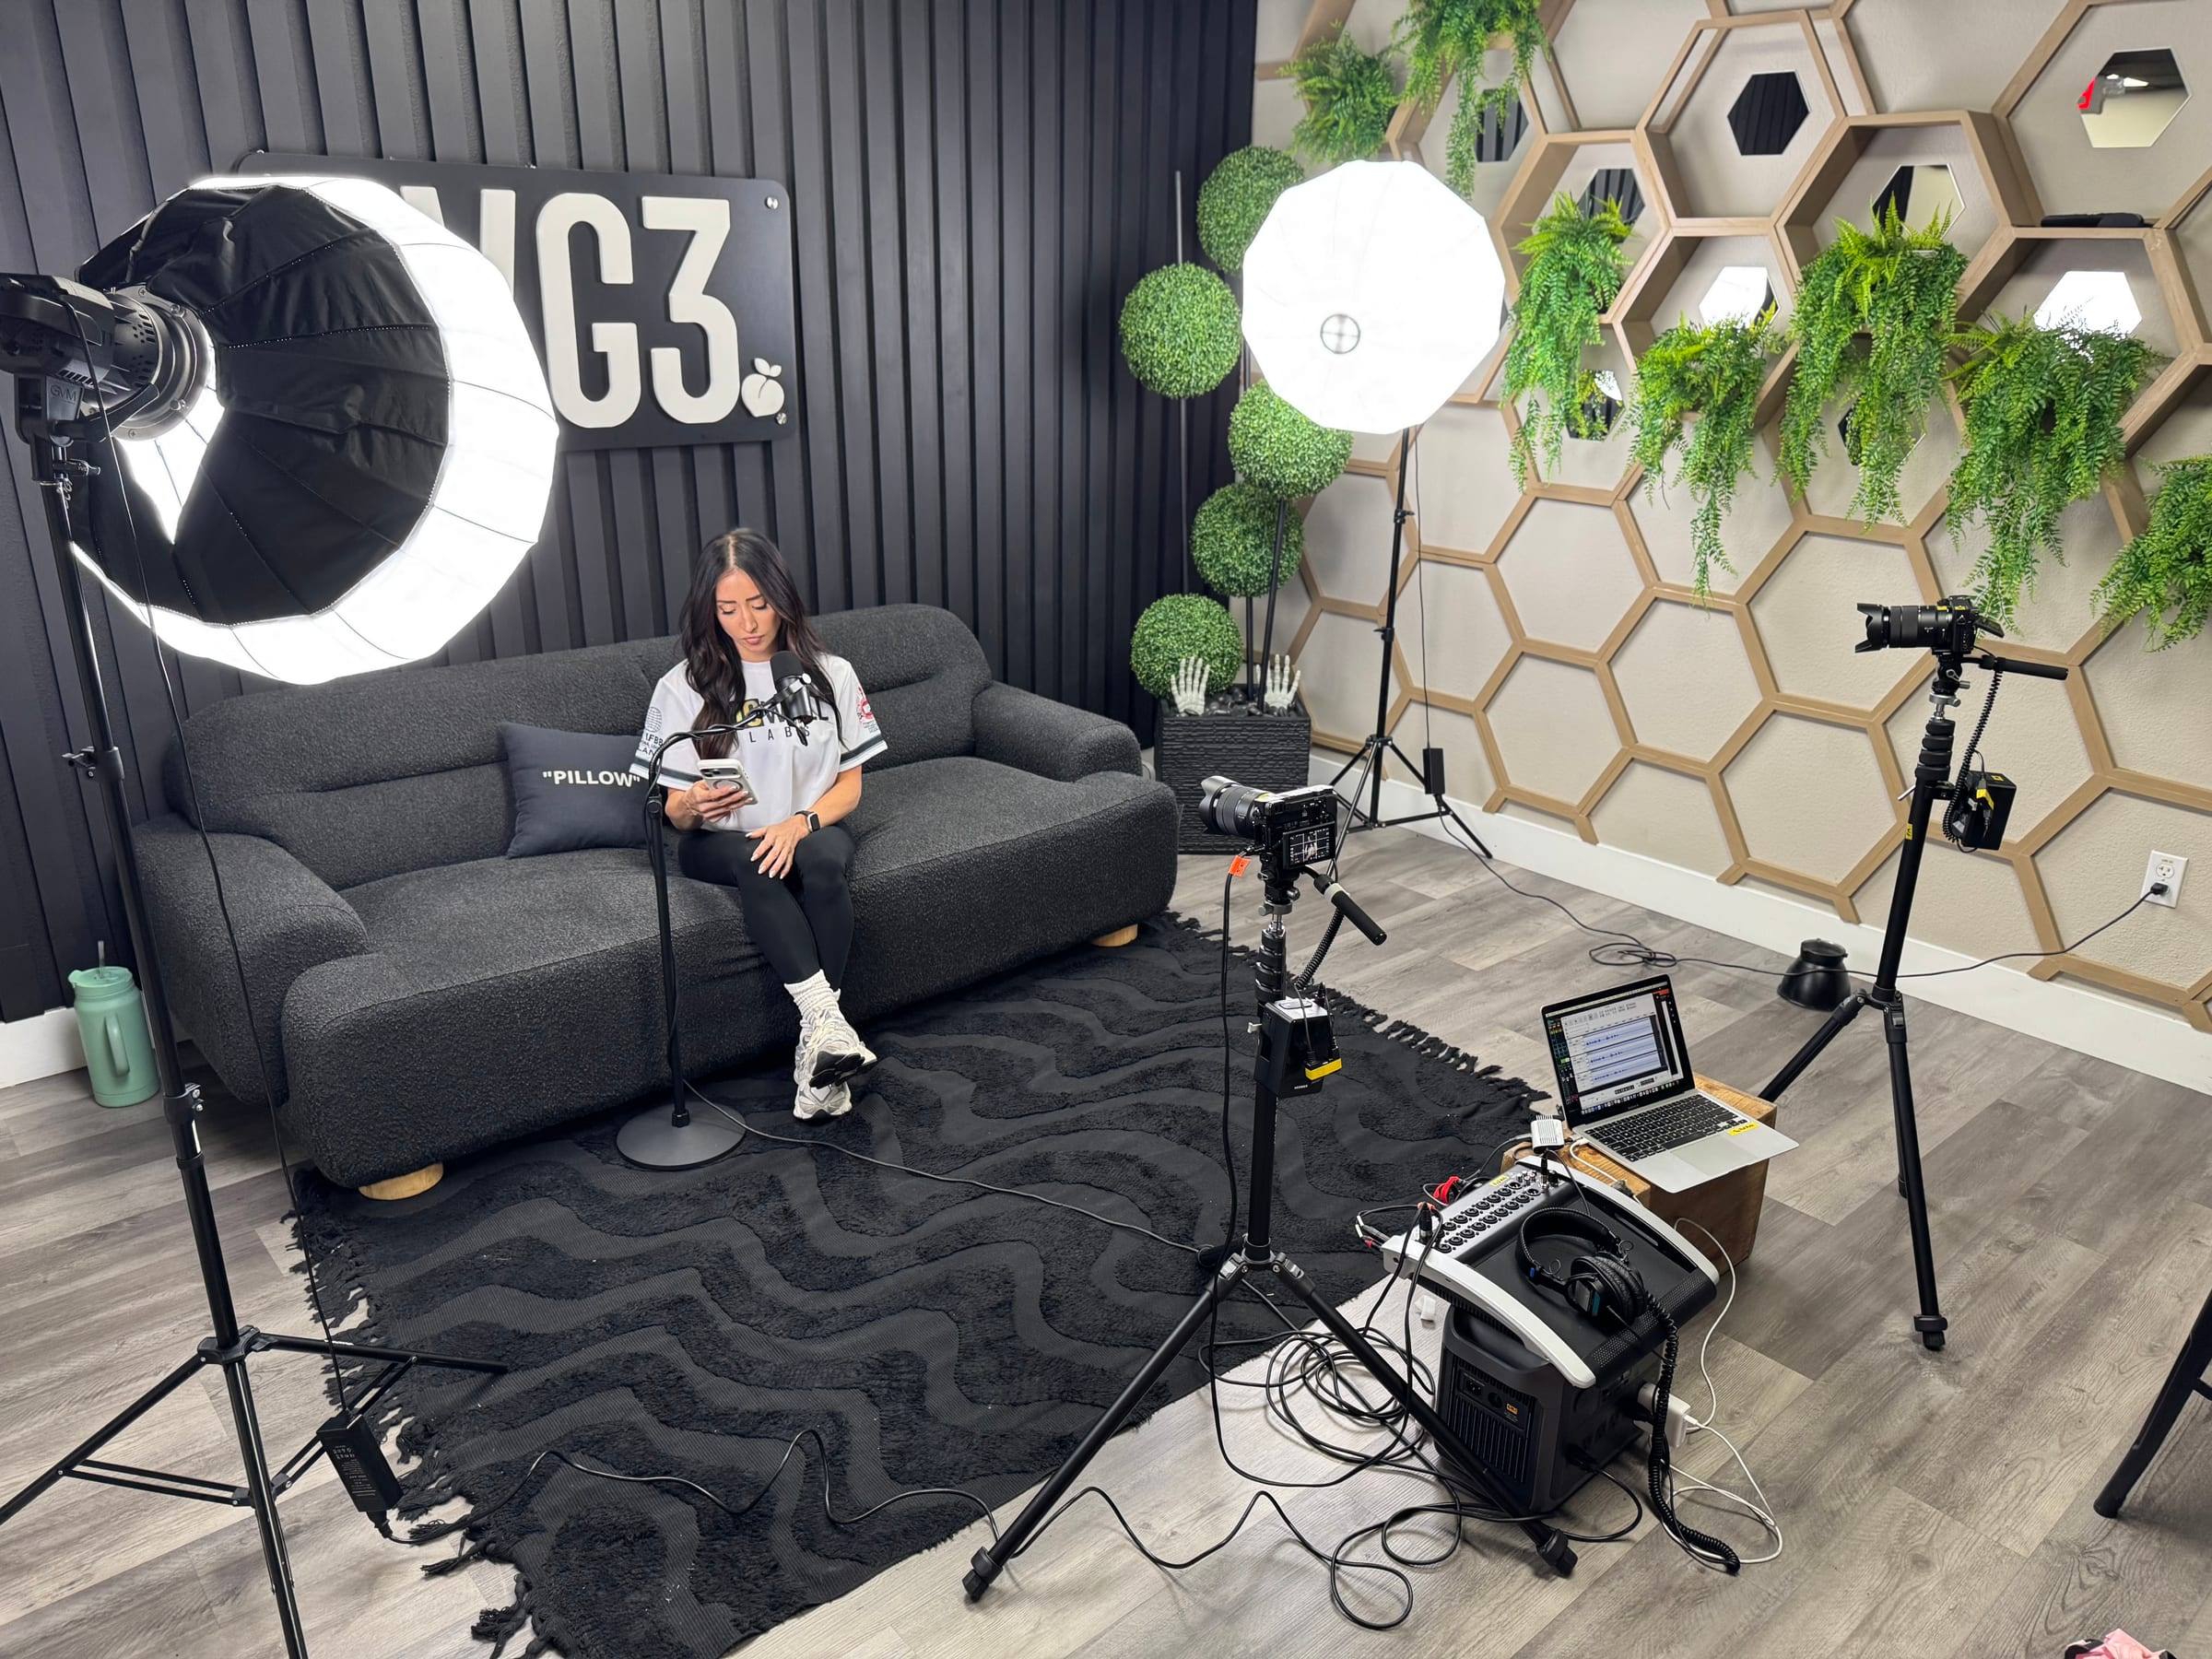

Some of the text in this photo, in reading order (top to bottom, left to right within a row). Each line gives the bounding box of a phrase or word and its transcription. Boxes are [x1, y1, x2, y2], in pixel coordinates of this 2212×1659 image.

[50, 384, 76, 402] GVM
[748, 726, 810, 743] LABS
[542, 770, 641, 788] "PILLOW"
